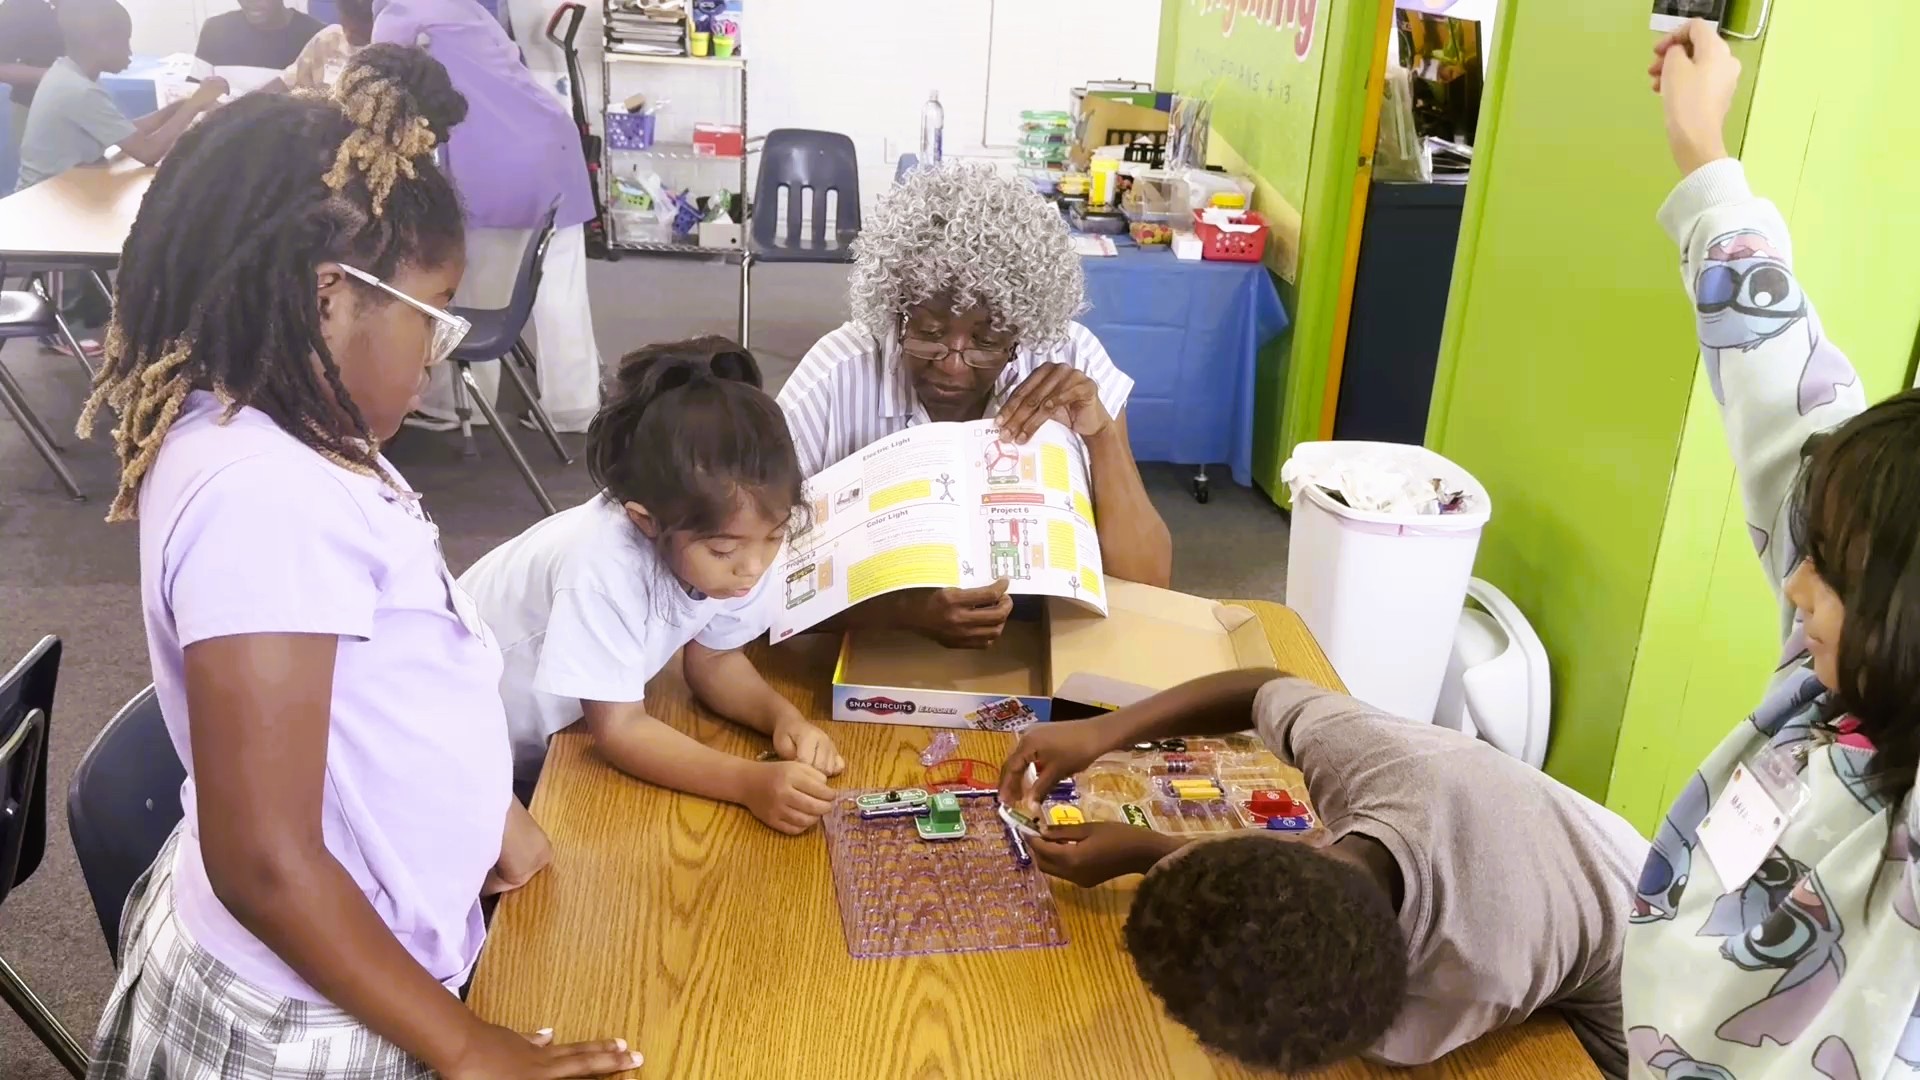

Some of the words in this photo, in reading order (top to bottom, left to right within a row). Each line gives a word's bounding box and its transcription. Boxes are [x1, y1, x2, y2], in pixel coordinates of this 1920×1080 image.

[891, 437, 910, 448] Light
[991, 507, 1022, 515] Project
[866, 516, 887, 529] Color
[888, 509, 909, 520] Light
[874, 702, 913, 711] CIRCUITS
